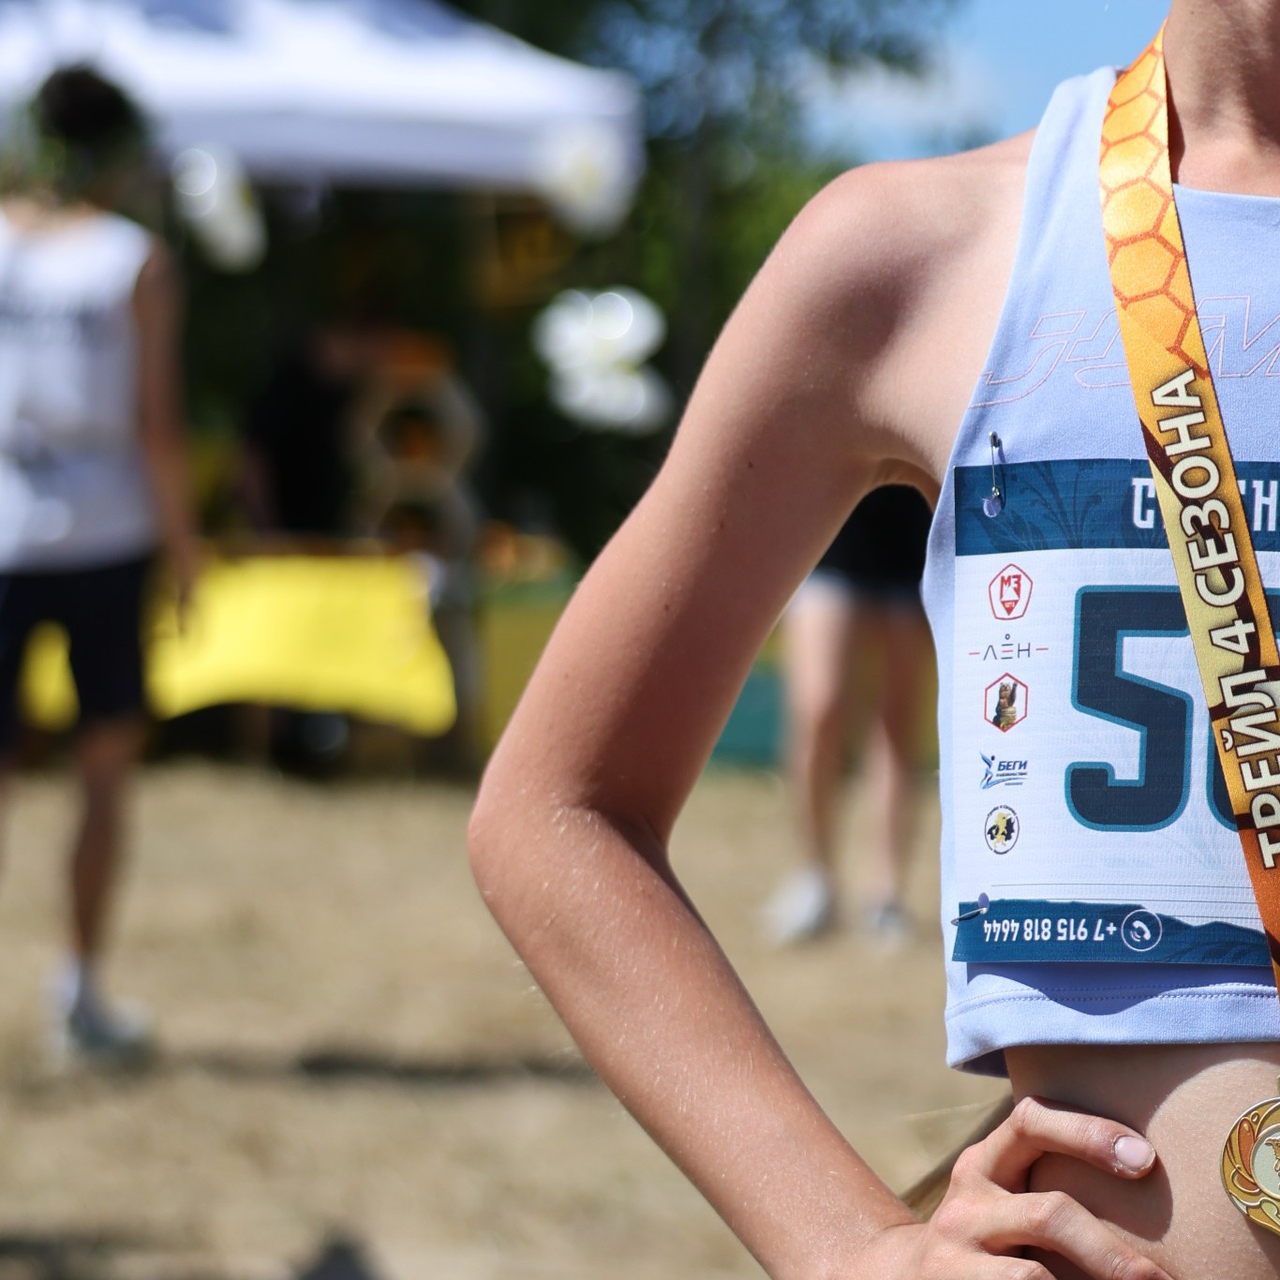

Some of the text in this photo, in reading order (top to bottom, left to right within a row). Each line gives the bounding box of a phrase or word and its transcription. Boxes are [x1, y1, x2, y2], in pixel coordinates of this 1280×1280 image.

[1151, 368, 1246, 607] СЕЗОНА
[1209, 618, 1256, 656] 4
[997, 760, 1029, 772] БЕГИ
[983, 918, 1118, 943] +7 915 818 4644
